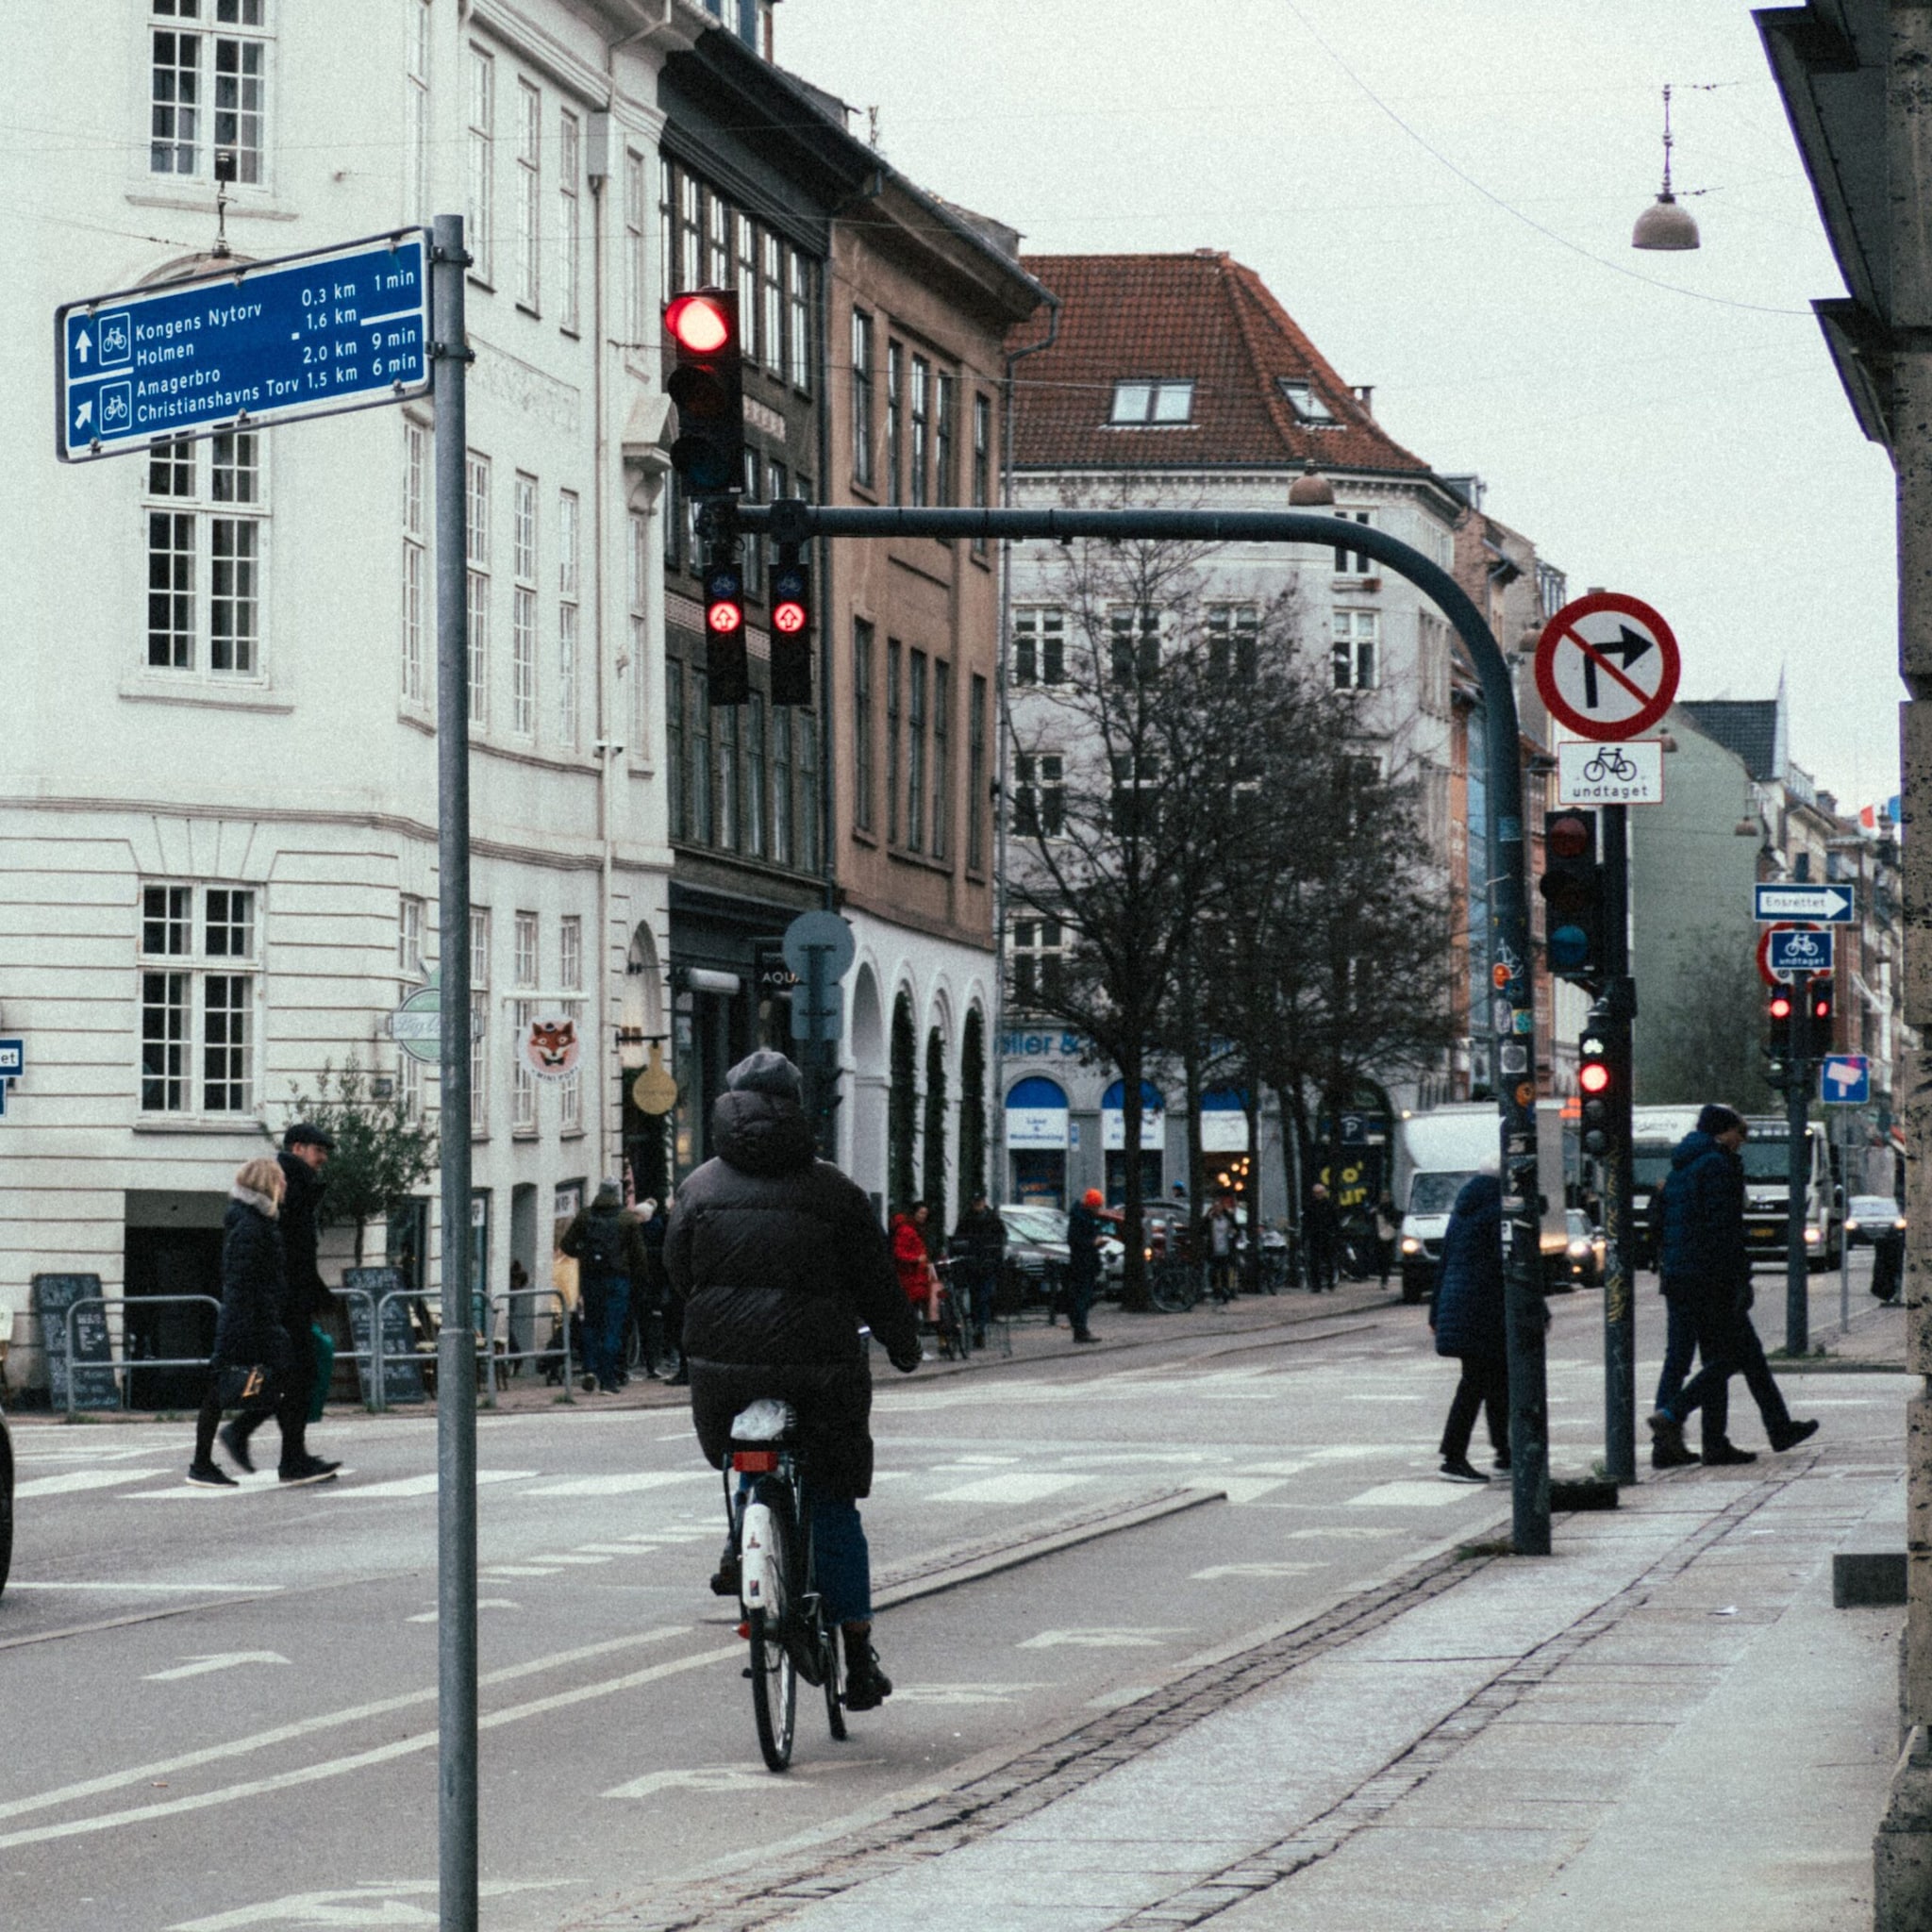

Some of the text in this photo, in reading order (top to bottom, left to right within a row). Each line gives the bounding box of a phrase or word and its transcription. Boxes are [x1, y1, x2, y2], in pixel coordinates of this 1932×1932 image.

[136, 270, 414, 341] Kongens Nytorv 0,3 km 1 min
[137, 308, 357, 367] Holmen 1,6 km
[137, 327, 416, 397] Amagerbro 2,0 km 9 min
[138, 353, 416, 422] Christianshavns Torv 1,5 km 6 min
[1573, 786, 1648, 799] undtaget
[1765, 896, 1825, 907] Ensrettet
[1779, 957, 1824, 966] undtaget
